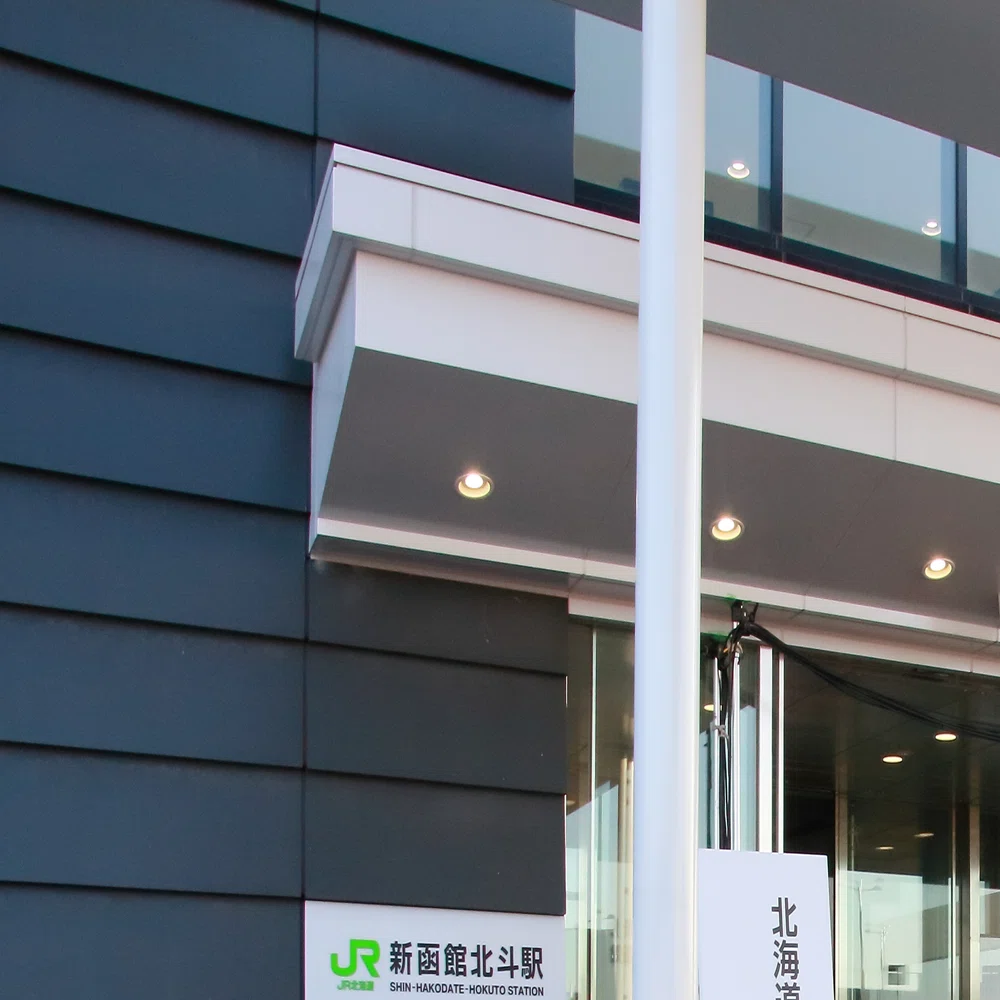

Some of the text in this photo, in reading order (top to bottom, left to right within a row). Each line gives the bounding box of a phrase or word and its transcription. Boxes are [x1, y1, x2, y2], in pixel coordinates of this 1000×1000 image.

[330, 939, 380, 978] JR
[390, 941, 544, 980] 新函館北斗駅
[389, 981, 544, 997] SHIN-HAKODATE-HOKUTO STATION
